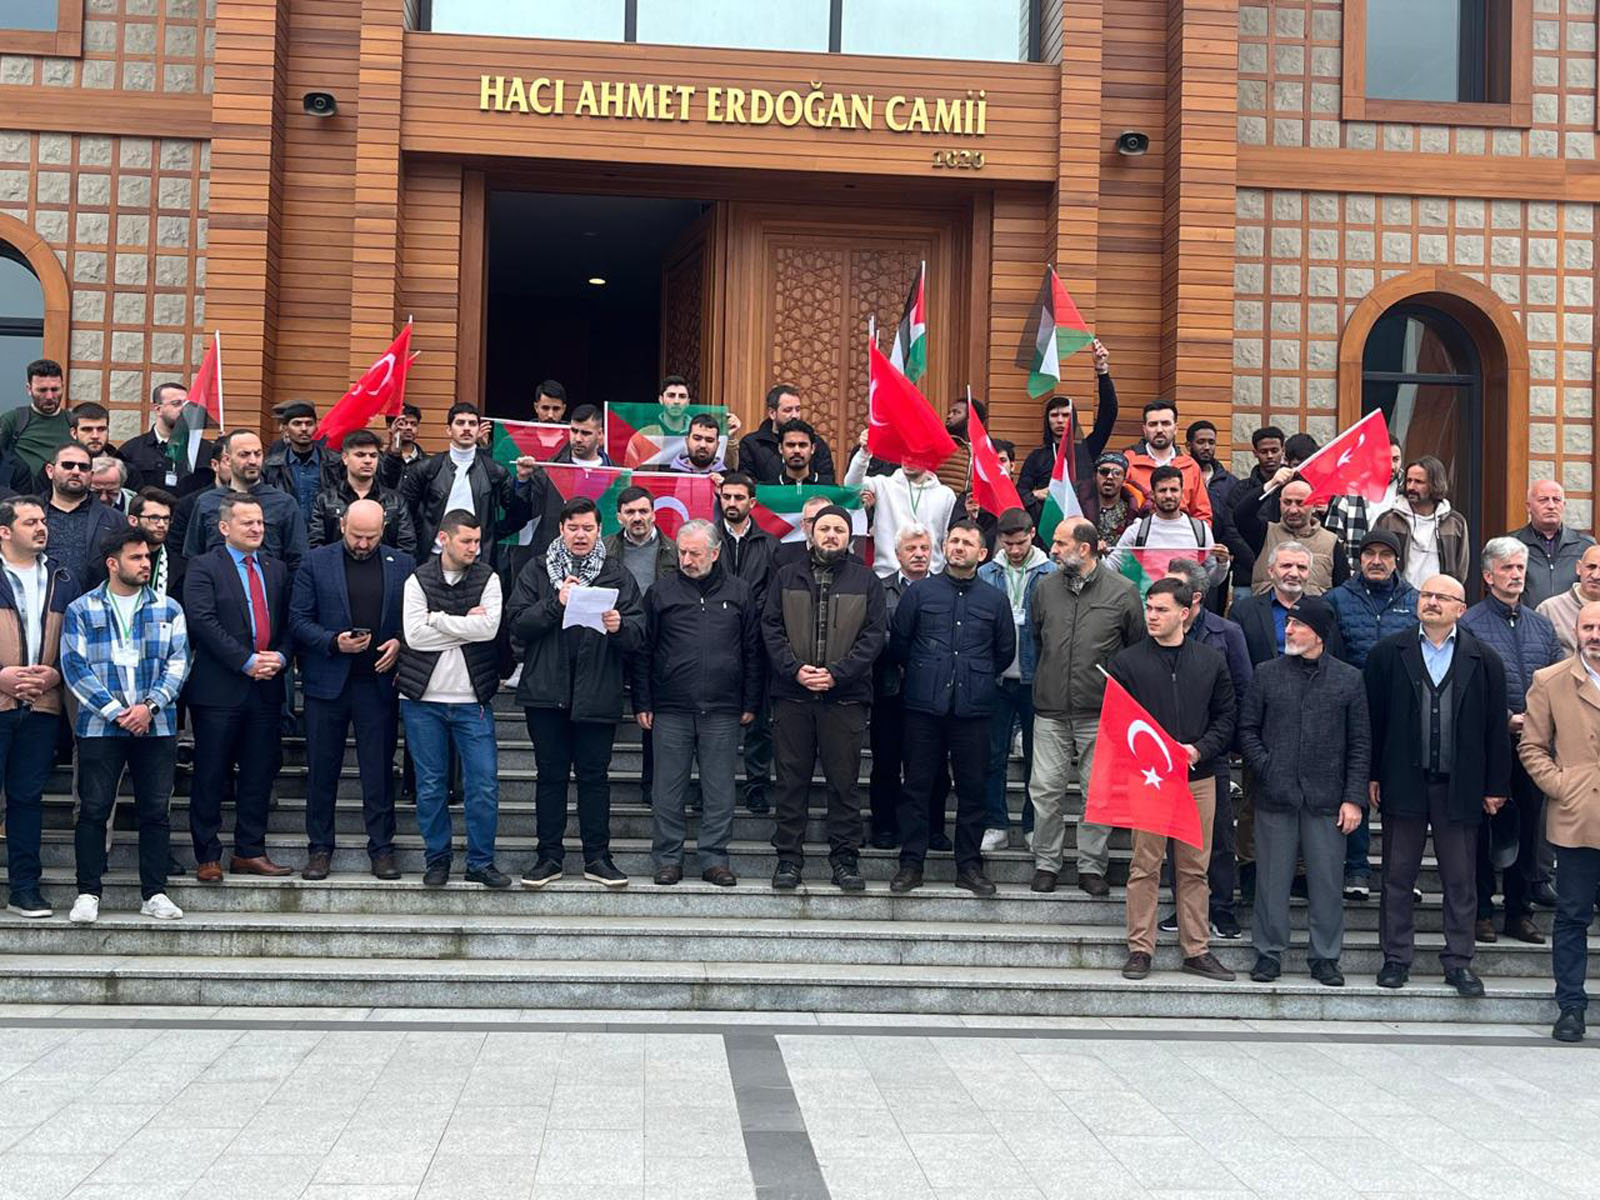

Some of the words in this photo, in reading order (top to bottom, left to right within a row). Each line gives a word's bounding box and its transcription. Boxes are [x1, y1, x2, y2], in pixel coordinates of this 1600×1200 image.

[480, 75, 565, 114] HACI
[575, 80, 696, 121] AHMET
[707, 79, 874, 130] ERDOĞAN
[885, 90, 987, 135] CAMİİ
